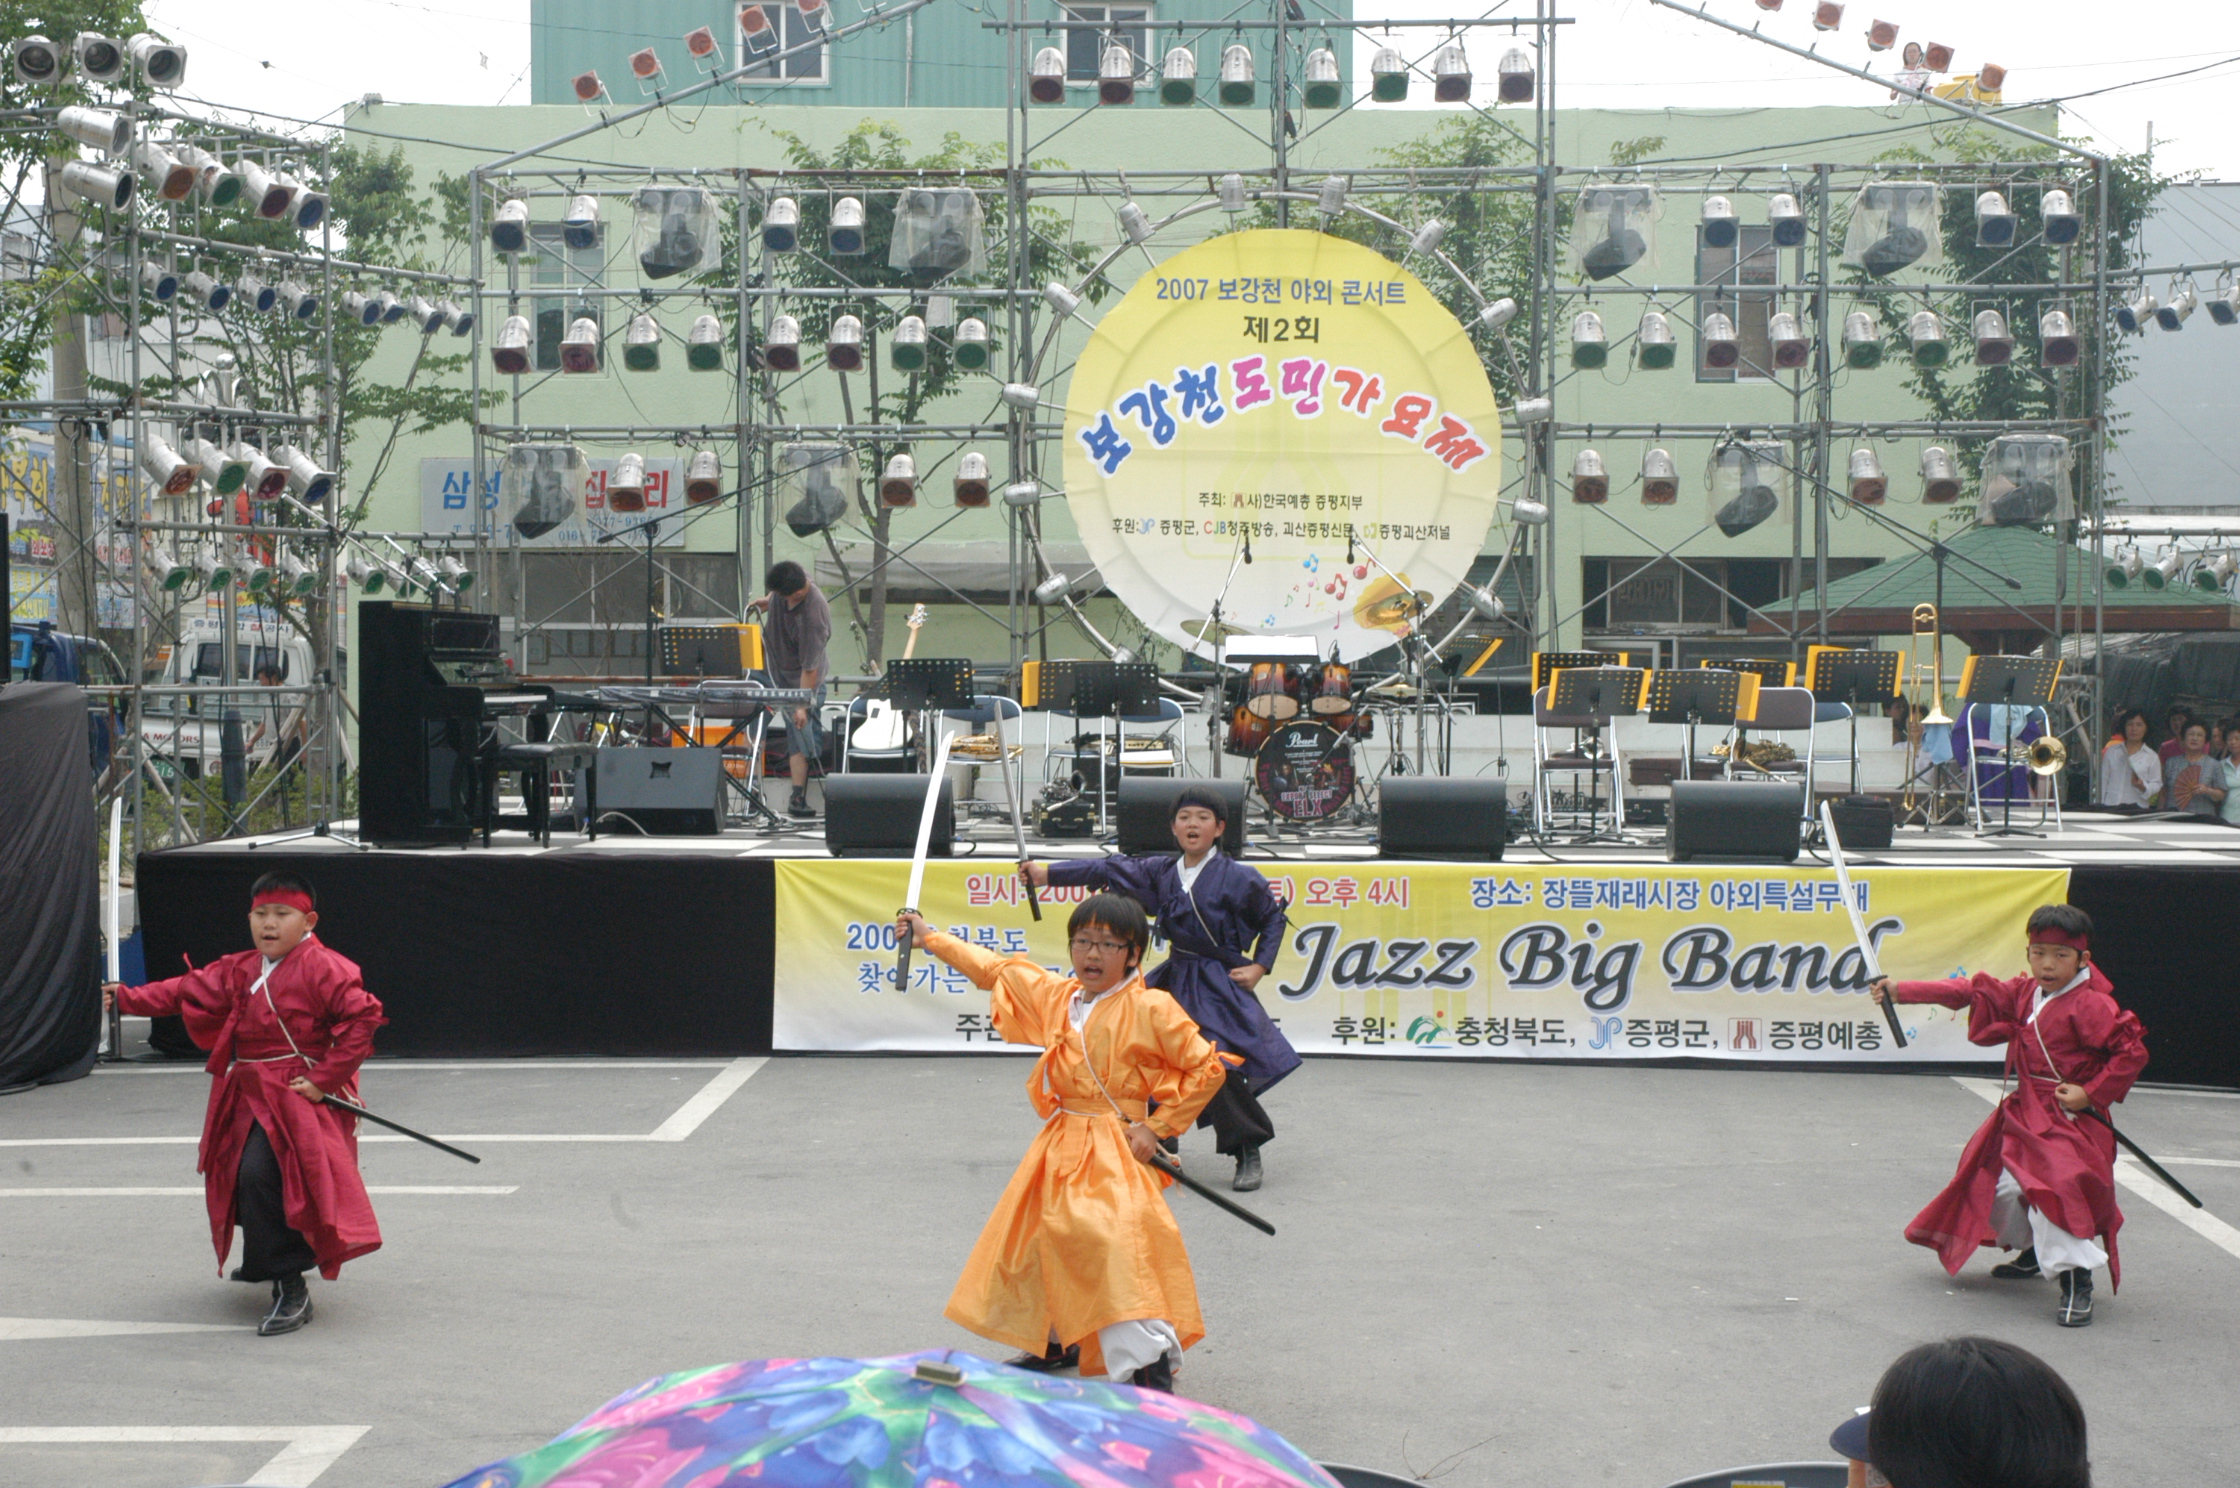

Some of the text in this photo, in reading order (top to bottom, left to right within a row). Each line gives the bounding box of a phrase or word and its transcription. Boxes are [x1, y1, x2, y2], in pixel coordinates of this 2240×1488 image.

[1156, 278, 1406, 306] 2007 보강천 야외 콘서트
[1244, 316, 1320, 343] 제2회
[1199, 492, 1363, 511] 주최: 사)한국예총 증평지부
[1113, 518, 1139, 534] 후원:
[1160, 520, 1199, 536] 증평군,
[1379, 524, 1451, 540] 증평괴산저널
[1285, 731, 1319, 748] Pearl
[1294, 799, 1323, 817] ELX
[967, 876, 1027, 905] 일시:
[1306, 880, 1358, 907] 오후
[1368, 879, 1408, 907] 4시
[1472, 879, 1531, 908] 장소:
[1543, 880, 1700, 910] 장뜰재래시장
[1279, 919, 1900, 1011] Jazz Big Band
[1332, 1017, 1395, 1044] 후원:
[1455, 1017, 1576, 1047] 충청북도,
[1625, 1019, 1718, 1048] 증평군,
[1769, 1022, 1883, 1050] 증평예총
